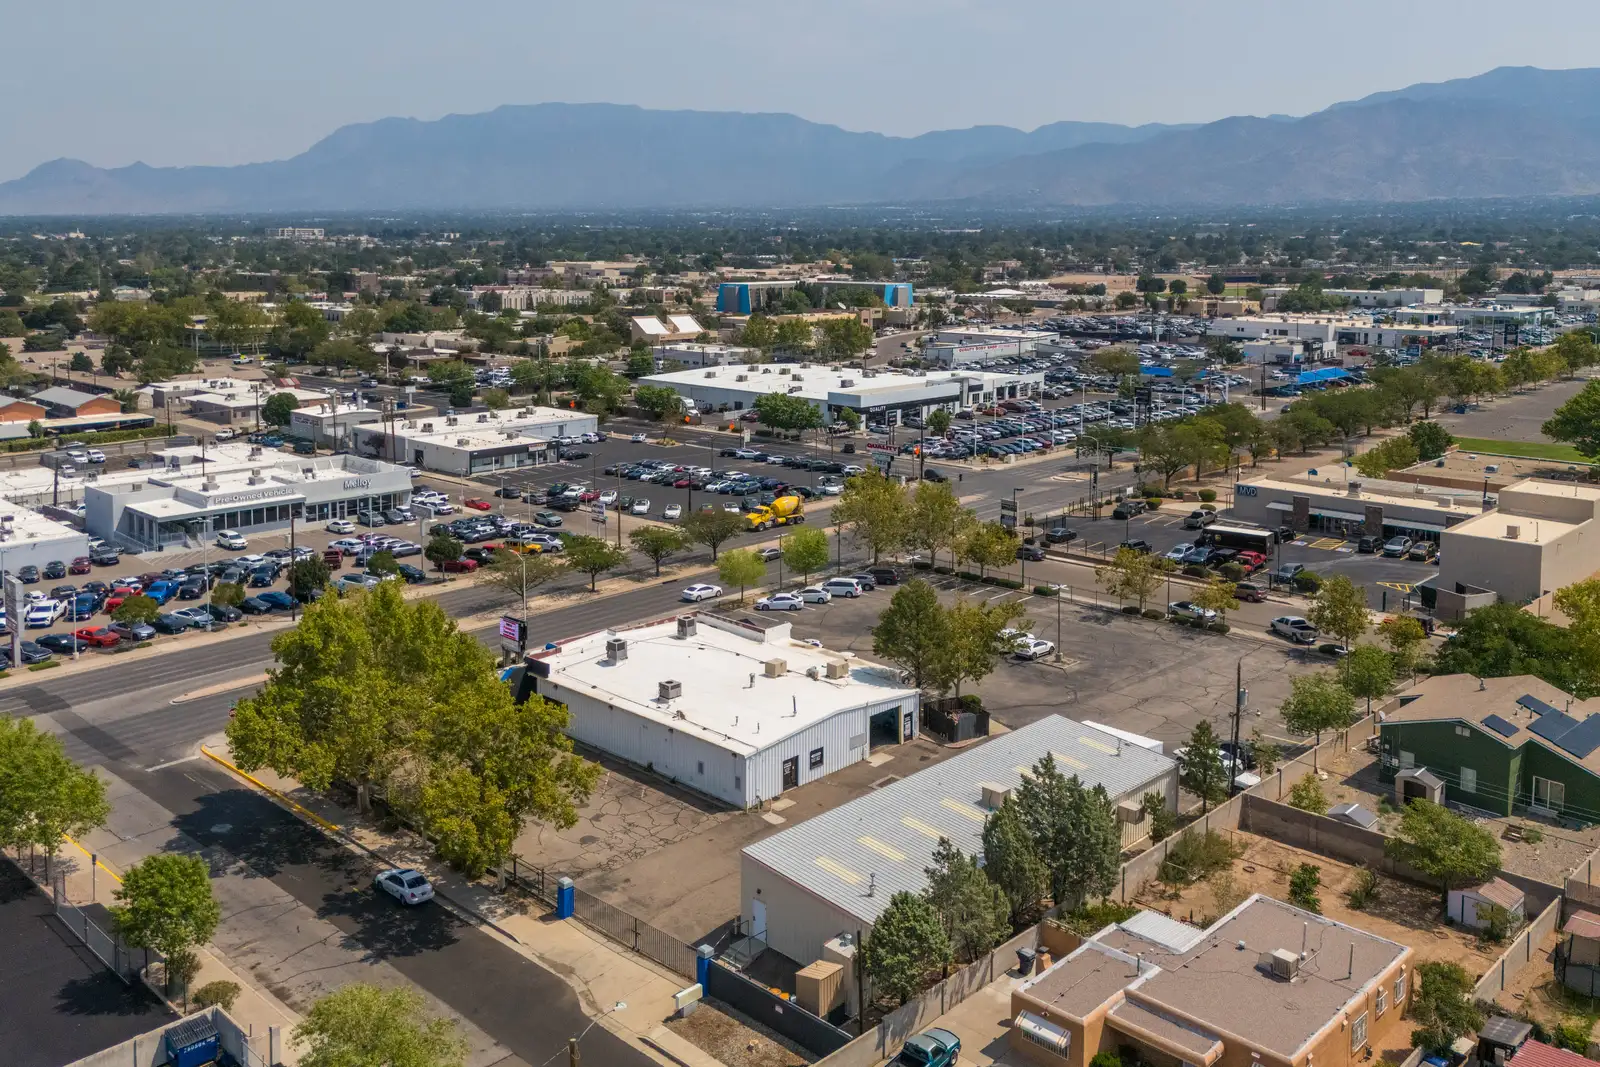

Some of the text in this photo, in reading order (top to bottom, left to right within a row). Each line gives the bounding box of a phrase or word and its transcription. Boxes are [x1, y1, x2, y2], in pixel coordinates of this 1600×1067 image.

[869, 405, 887, 413] QUALITY
[866, 442, 898, 452] QUALITY
[343, 478, 373, 491] Melloy
[1239, 485, 1257, 497] MVD
[215, 492, 262, 504] Pre-Owned
